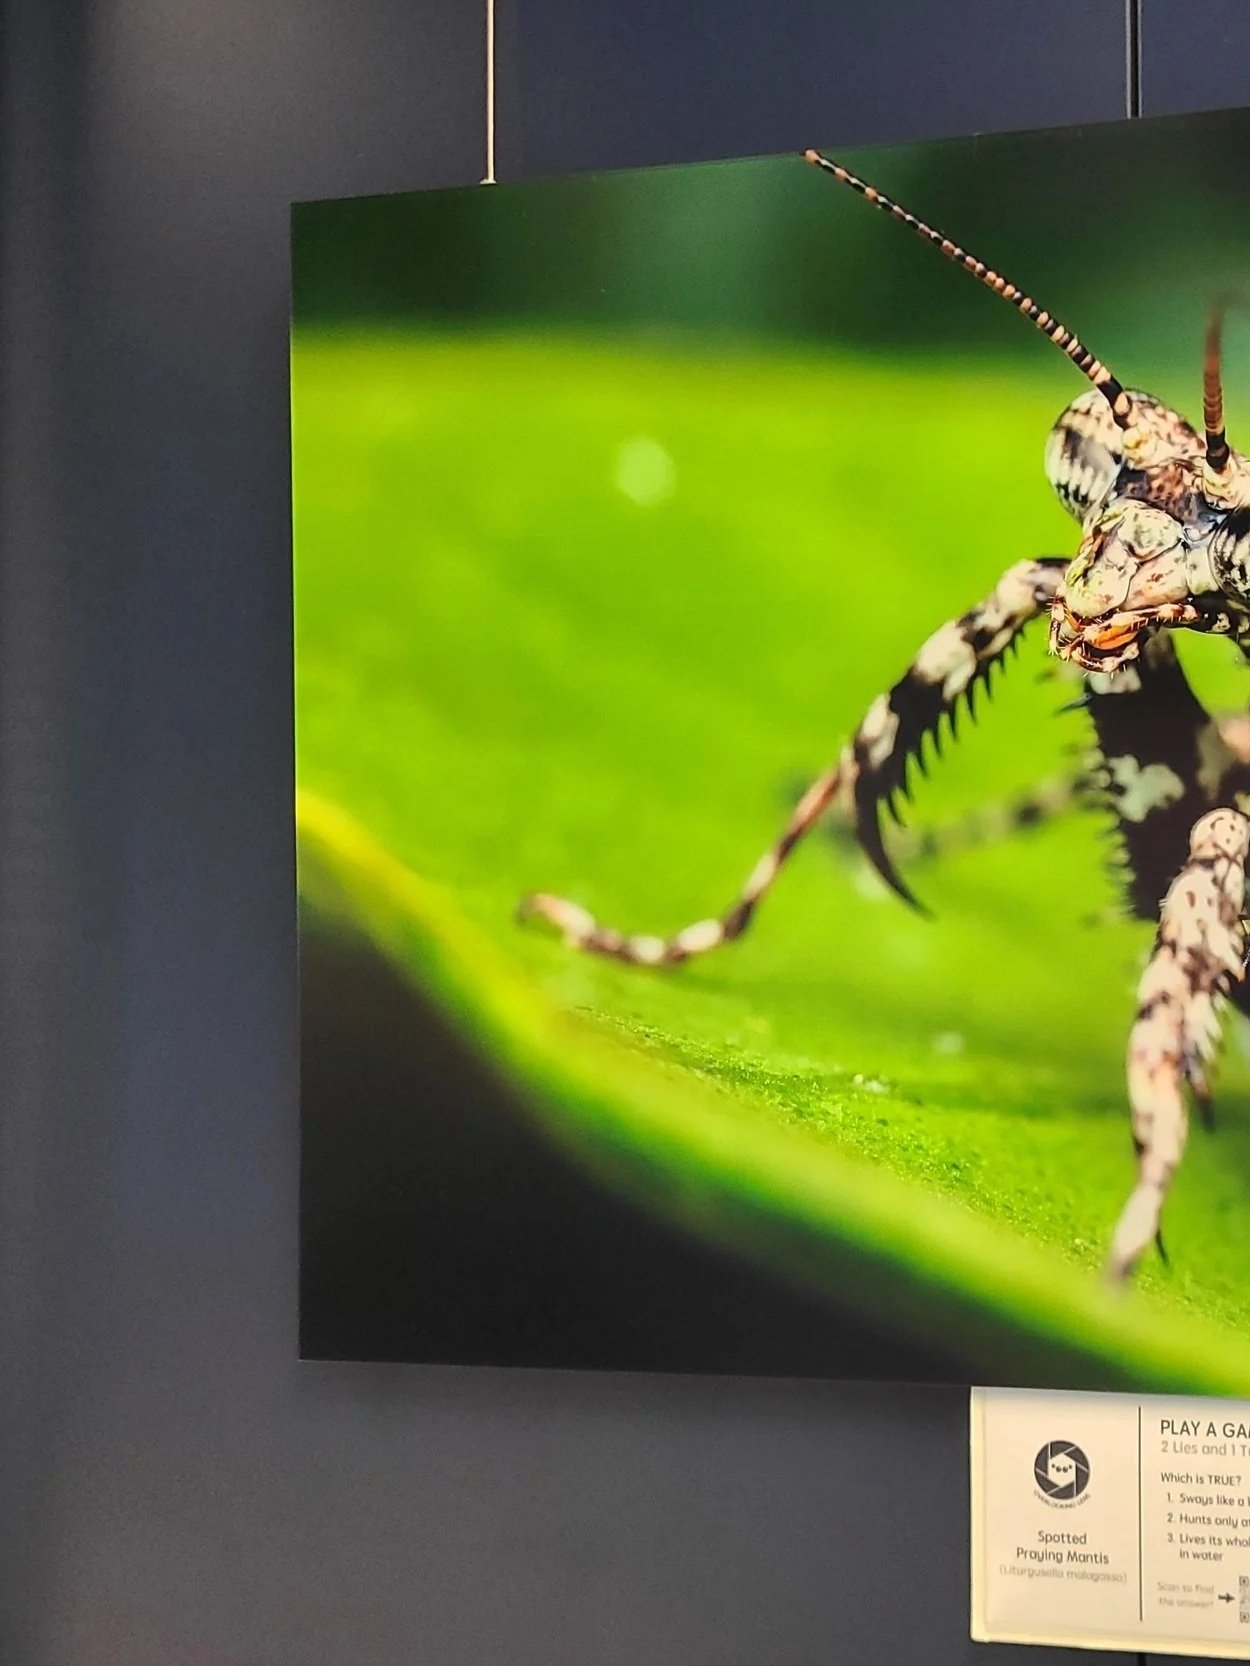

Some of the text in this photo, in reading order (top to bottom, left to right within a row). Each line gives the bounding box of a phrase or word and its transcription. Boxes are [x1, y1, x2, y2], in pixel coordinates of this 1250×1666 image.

[1160, 1419, 1201, 1437] PLAY
[1206, 1421, 1217, 1438] A
[1161, 1440, 1169, 1453] 2
[1173, 1441, 1198, 1454] Lies
[1201, 1443, 1227, 1456] and
[1160, 1472, 1242, 1487] Which is TRUE?
[1179, 1493, 1214, 1507] Sways
[1216, 1494, 1235, 1506] like
[1237, 1498, 1245, 1507] a
[1179, 1513, 1212, 1526] Hunts
[1214, 1515, 1239, 1529] only
[1038, 1530, 1087, 1546] Spotted
[1179, 1533, 1206, 1545] Lives
[1209, 1534, 1223, 1546] its
[1016, 1547, 1110, 1565] Praying Mantis
[1179, 1549, 1223, 1562] in water
